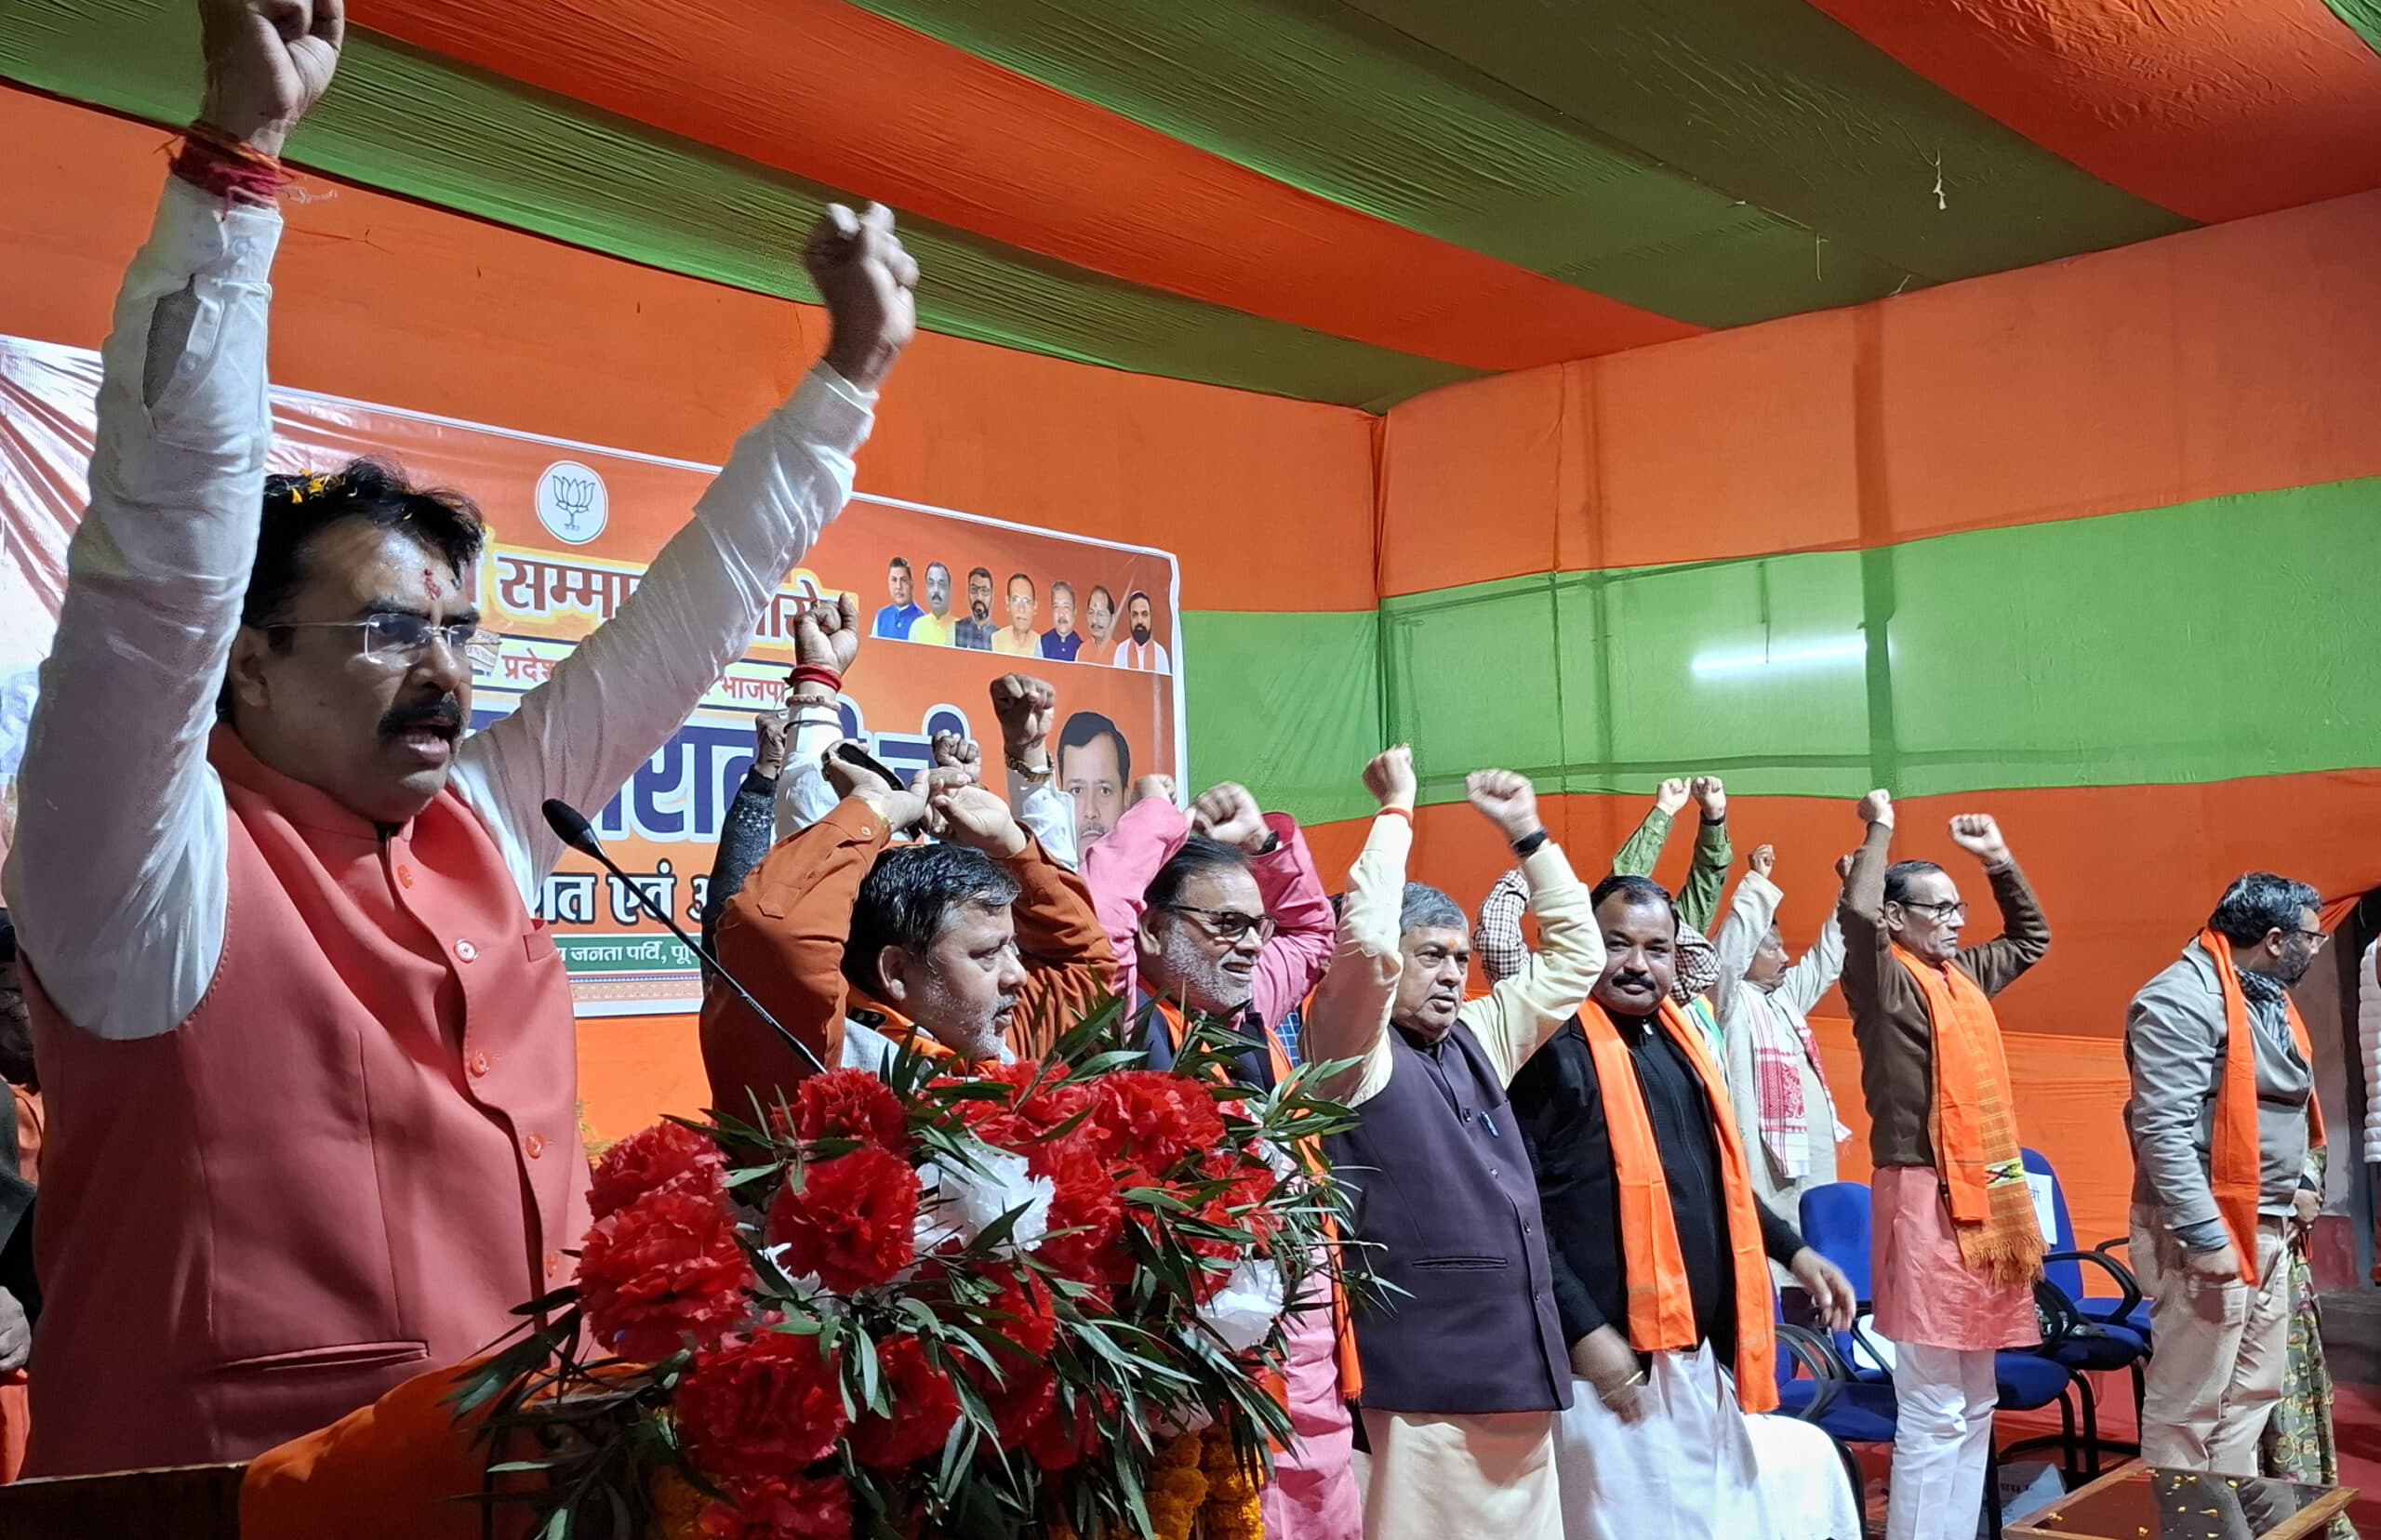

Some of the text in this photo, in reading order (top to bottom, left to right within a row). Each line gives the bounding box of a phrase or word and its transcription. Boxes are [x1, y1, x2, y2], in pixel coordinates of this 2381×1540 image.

[498, 556, 643, 618] सम्मा
[606, 859, 675, 924] एवं
[569, 946, 623, 962] जनता
